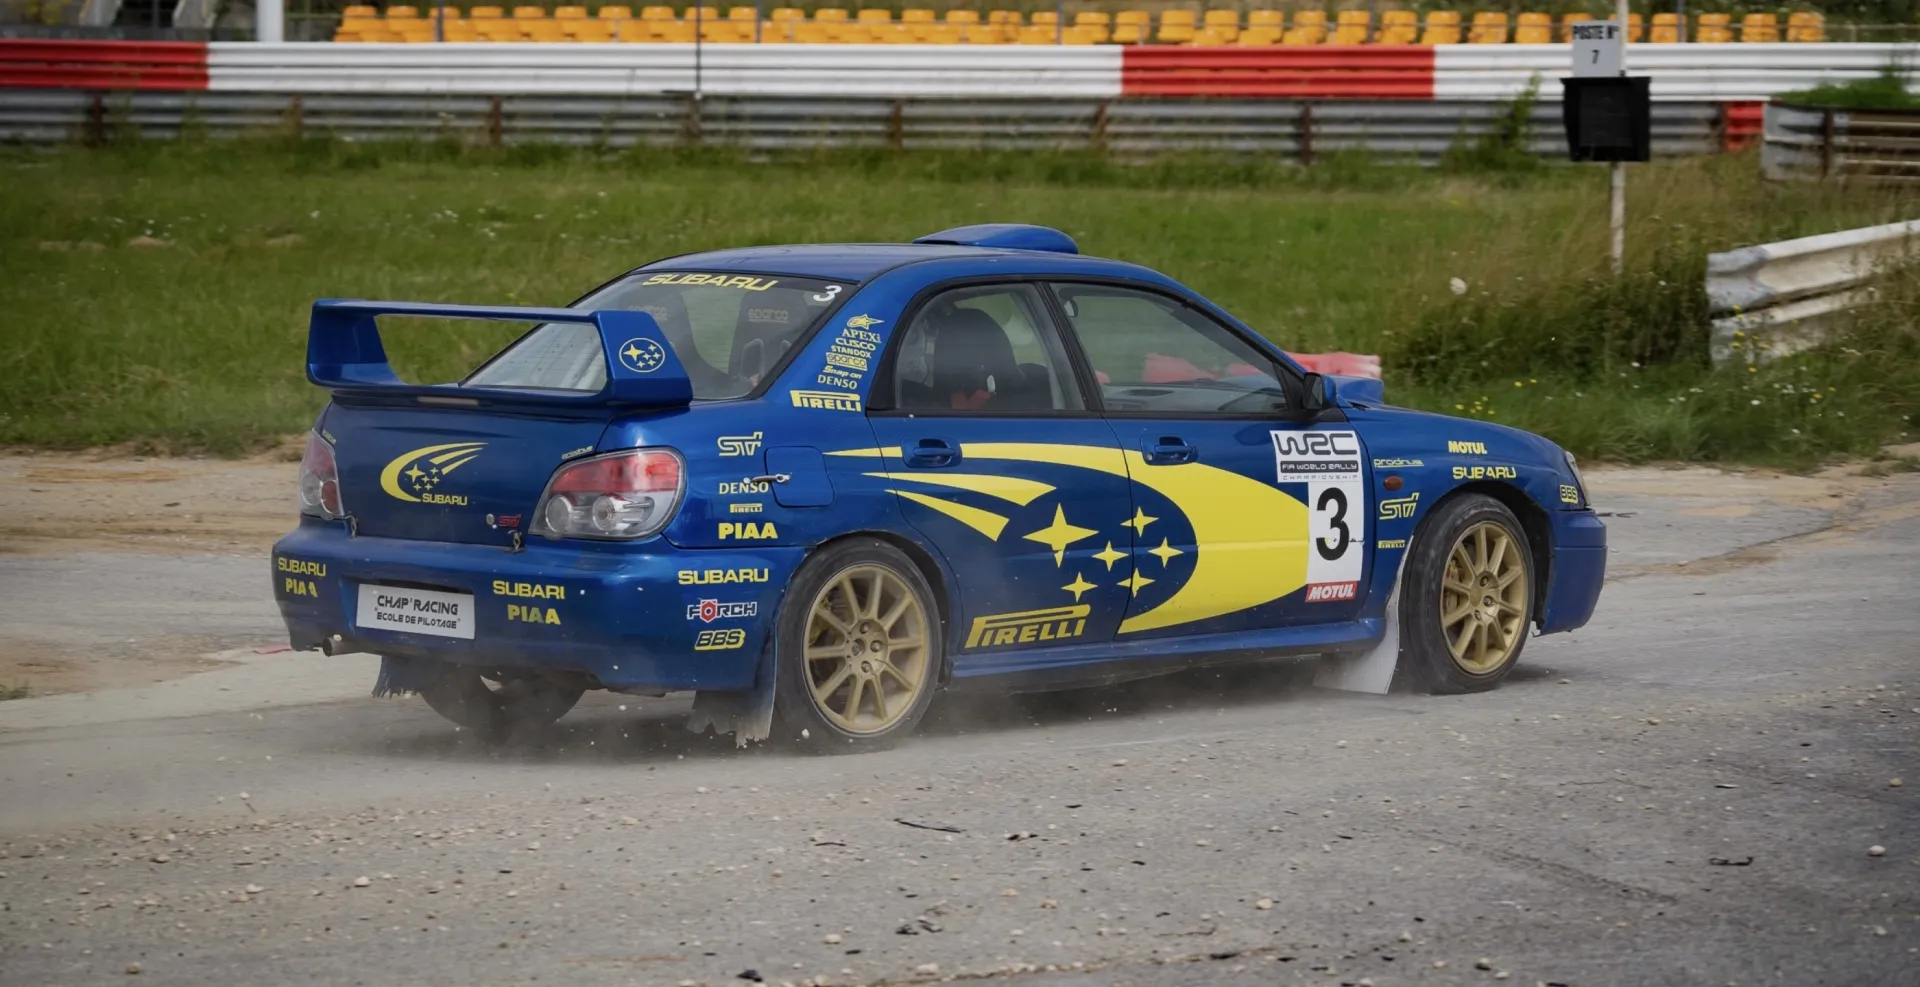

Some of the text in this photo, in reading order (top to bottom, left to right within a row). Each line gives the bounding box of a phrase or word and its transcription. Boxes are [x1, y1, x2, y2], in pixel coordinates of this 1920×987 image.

[1573, 25, 1603, 40] POSTE
[1592, 49, 1599, 64] 7
[642, 273, 778, 291] SUBARU
[813, 285, 842, 302] 3
[748, 309, 788, 321] sparco
[831, 345, 872, 359] STANDOX
[835, 337, 877, 351] CUSCO
[827, 353, 867, 367] sparco
[823, 365, 862, 379] Snap-on
[817, 374, 858, 390] DENSO
[789, 390, 862, 412] PIRELLI
[1274, 433, 1358, 456] WRC
[1448, 441, 1488, 454] MOTUL
[1452, 466, 1516, 480] SUBARU
[718, 481, 769, 495] DENSO
[1560, 485, 1578, 504] BBS
[421, 493, 467, 506] SUBARU
[730, 503, 763, 513] PIRELLI
[718, 522, 778, 540] PIAA
[1315, 487, 1350, 561] 3
[1378, 540, 1406, 549] PIRELLI
[278, 556, 326, 577] SUBARU
[678, 568, 769, 585] SUBARU
[285, 577, 318, 598] PIAA
[1308, 584, 1354, 600] MOTUL
[376, 612, 457, 629] ECOLE DE PILOTAGE
[507, 604, 562, 625] PIAA
[964, 604, 1092, 649] PIRELLI
[694, 628, 746, 651] BBS
